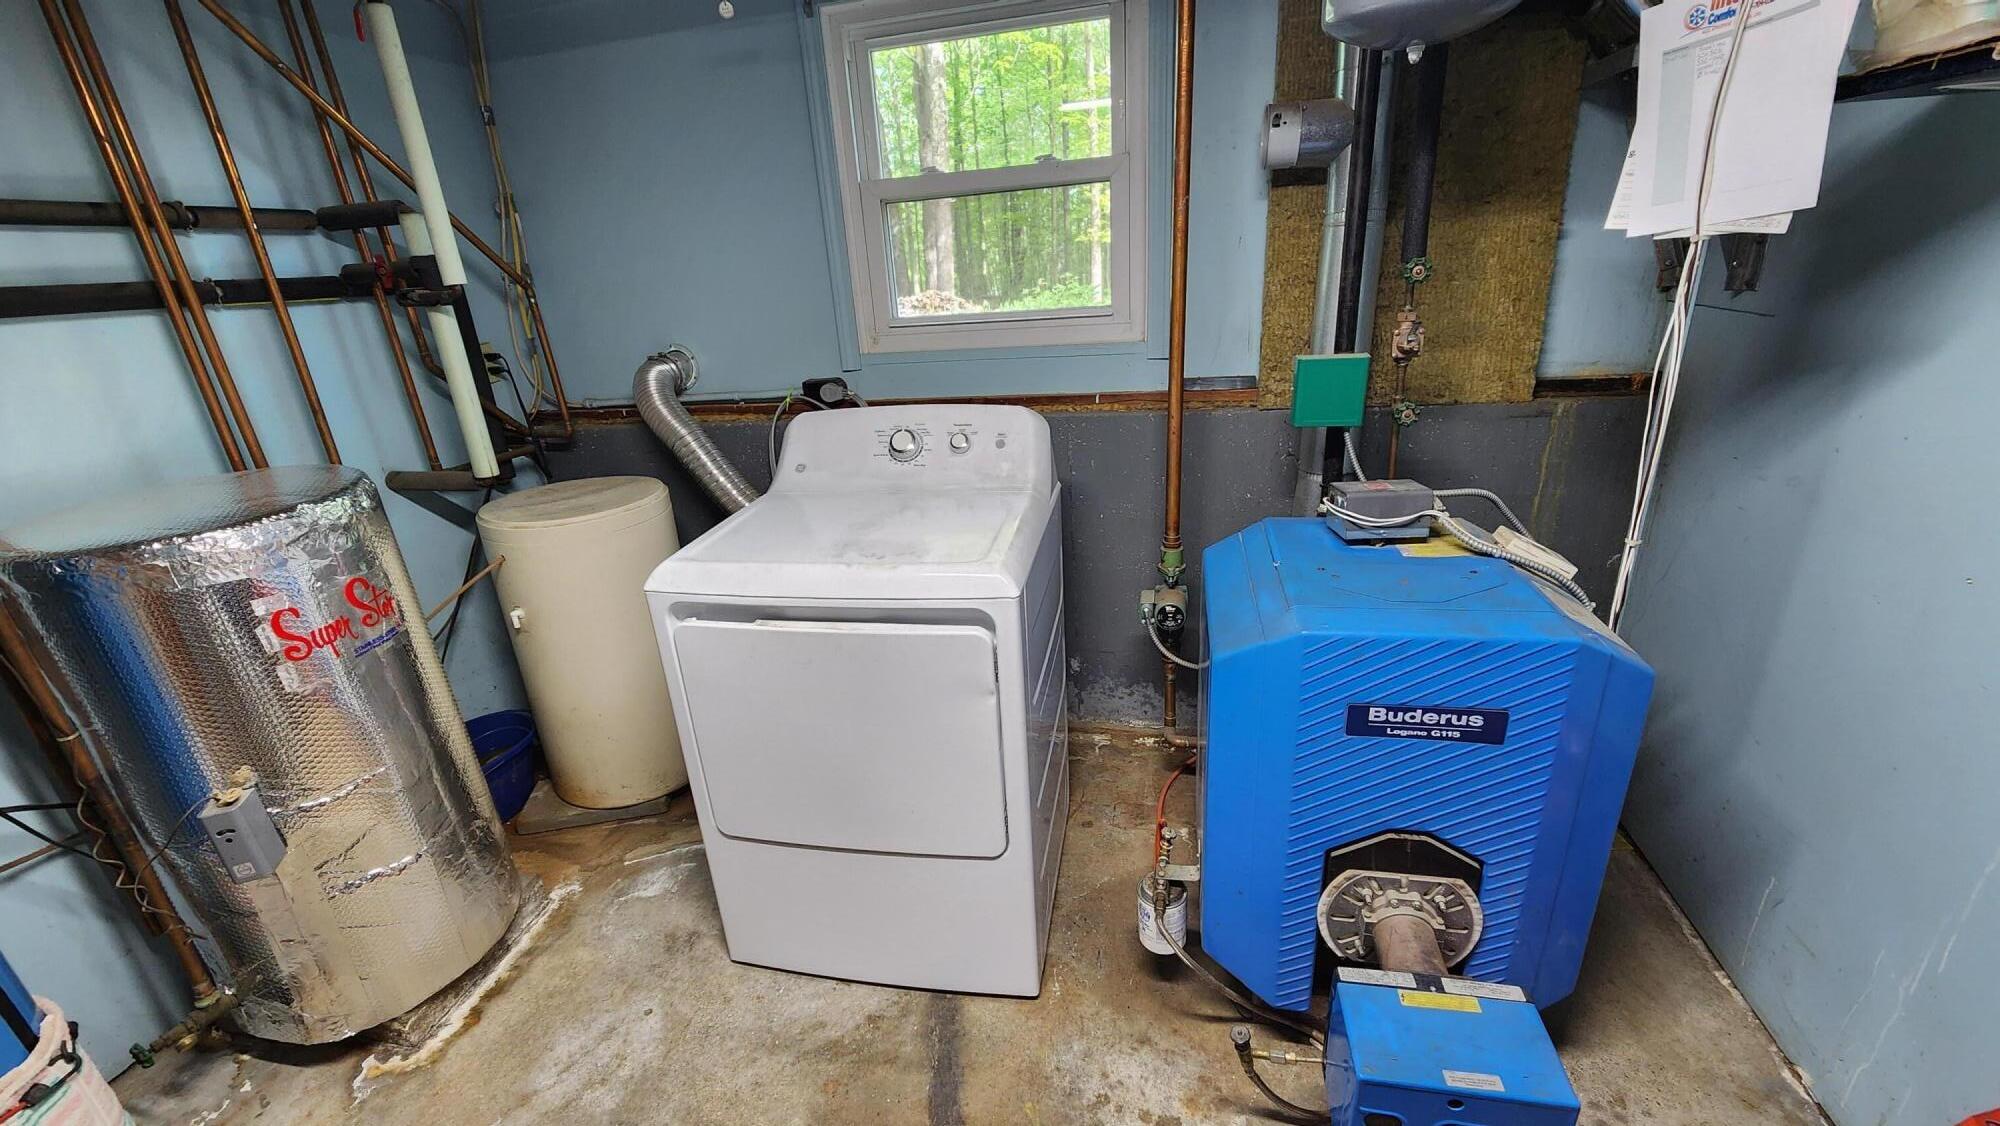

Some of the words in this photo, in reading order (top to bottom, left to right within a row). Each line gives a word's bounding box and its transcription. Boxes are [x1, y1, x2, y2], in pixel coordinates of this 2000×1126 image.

[271, 607, 359, 661] Super
[1369, 707, 1484, 727] Buderus
[1386, 728, 1428, 737] Logano
[1431, 730, 1461, 738] G115
